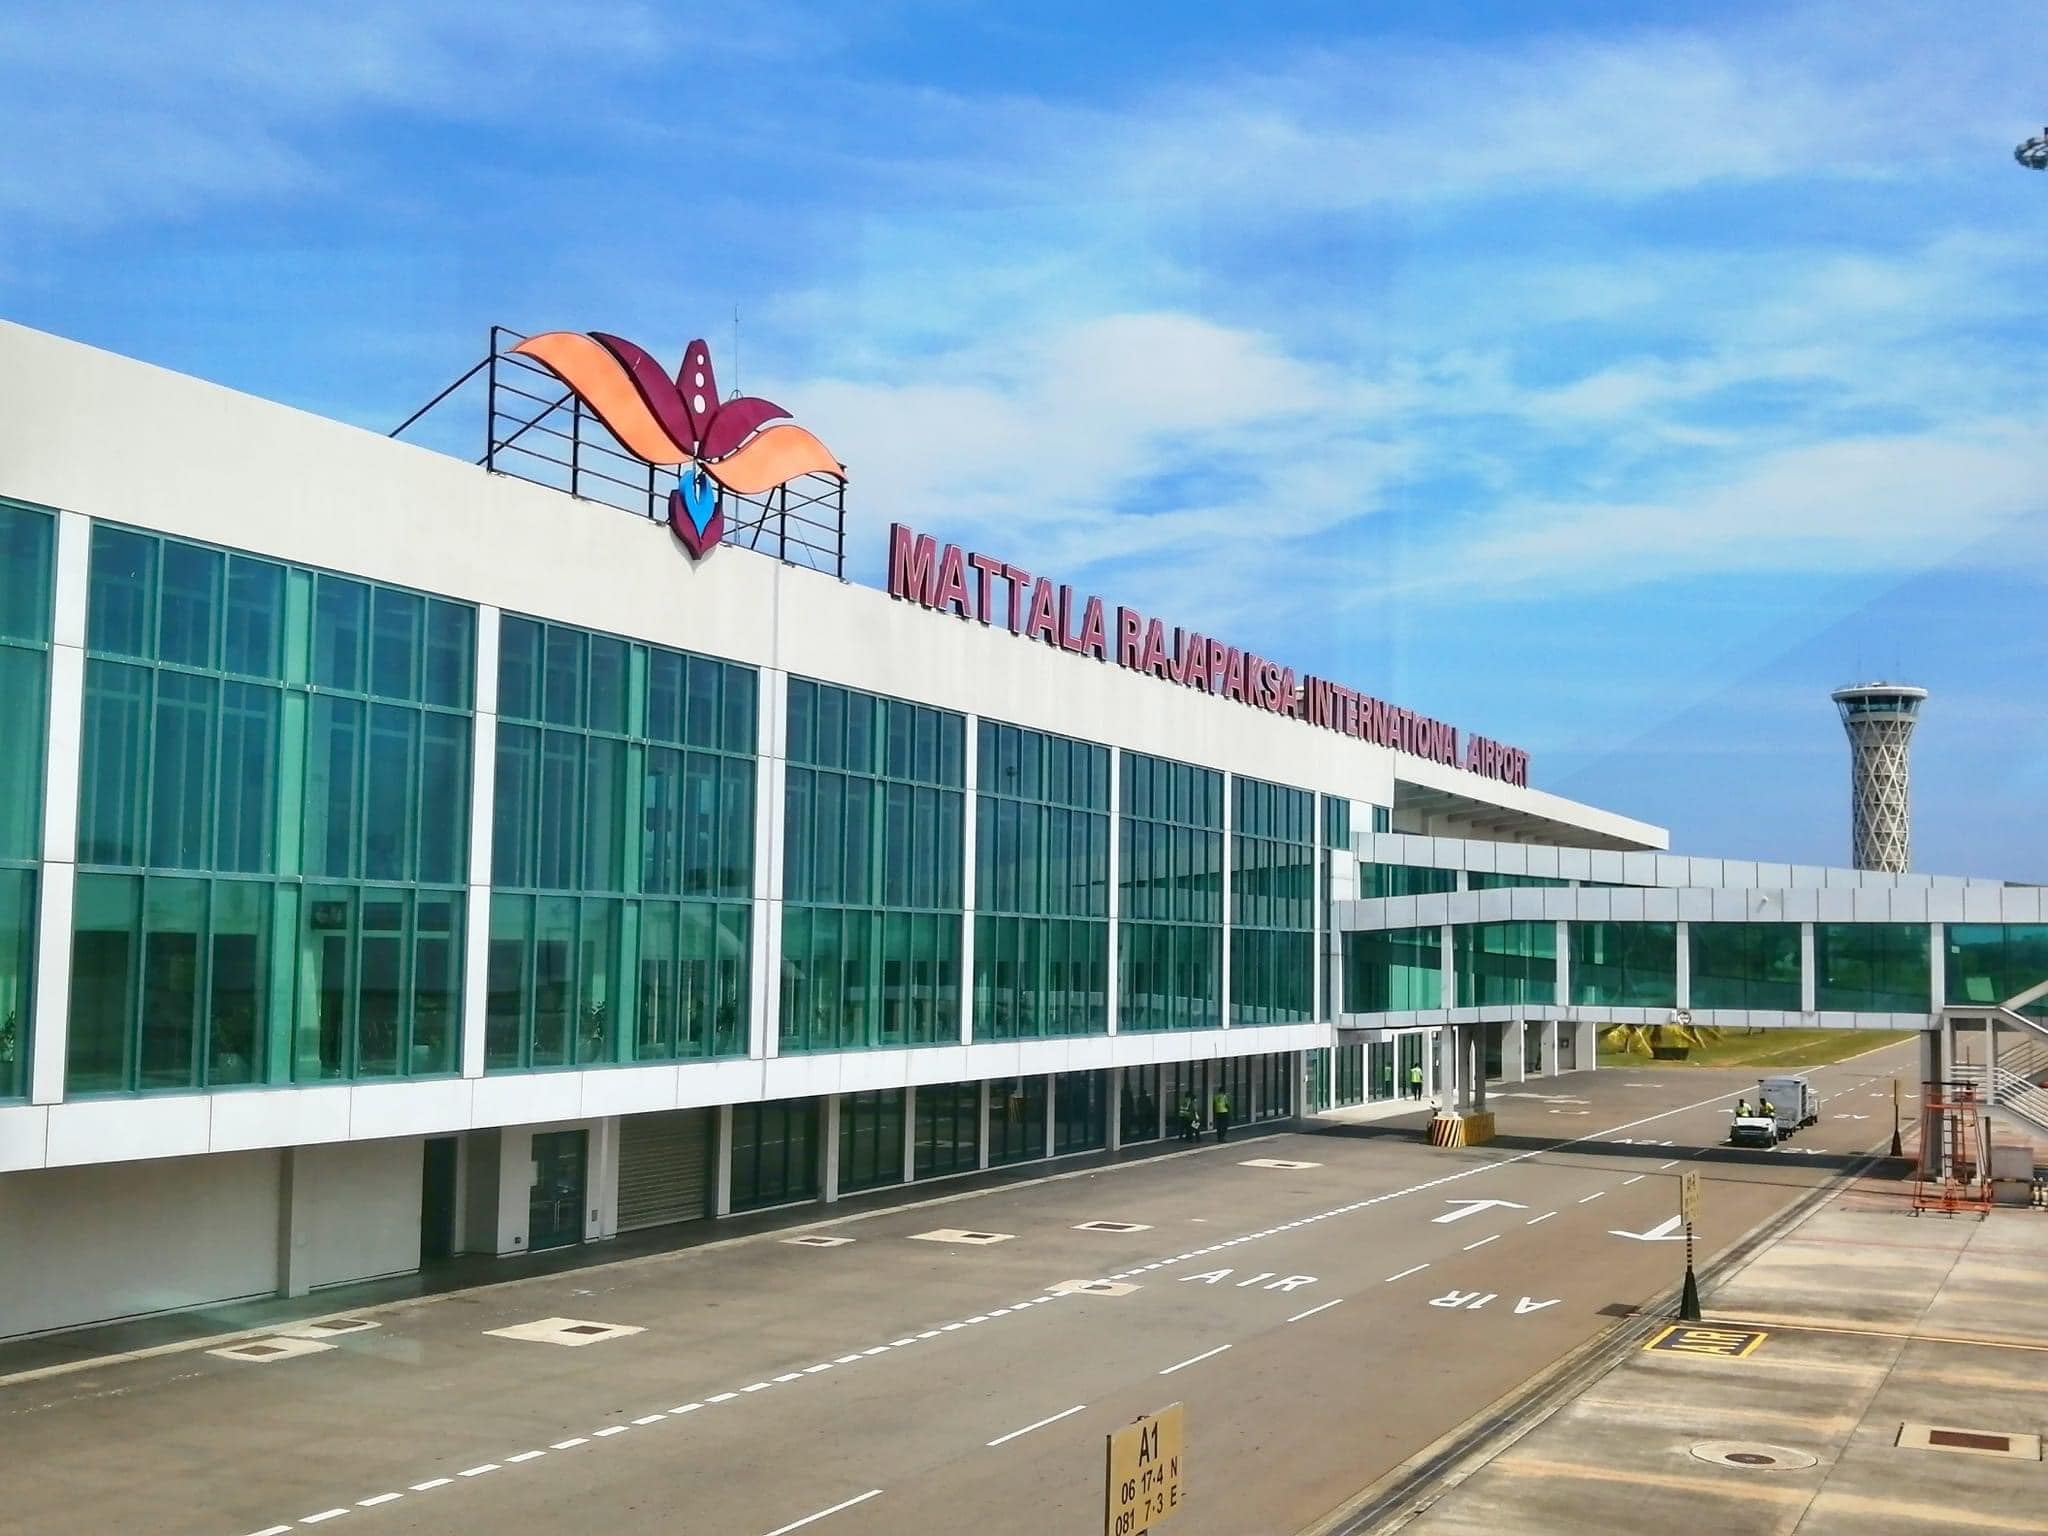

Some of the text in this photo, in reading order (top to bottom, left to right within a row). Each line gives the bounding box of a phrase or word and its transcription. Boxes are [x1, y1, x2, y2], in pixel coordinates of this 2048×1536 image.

[889, 523, 1530, 788] MATTALA RAJAPAKSA INTERNATIONAL AIRPORT
[1178, 1268, 1318, 1291] AIR
[1429, 1290, 1561, 1314] AIR
[1139, 1421, 1158, 1467] A1
[1121, 1479, 1136, 1505] 06
[1170, 1455, 1177, 1478] N
[1115, 1508, 1135, 1536] 081
[1170, 1485, 1177, 1507] E
